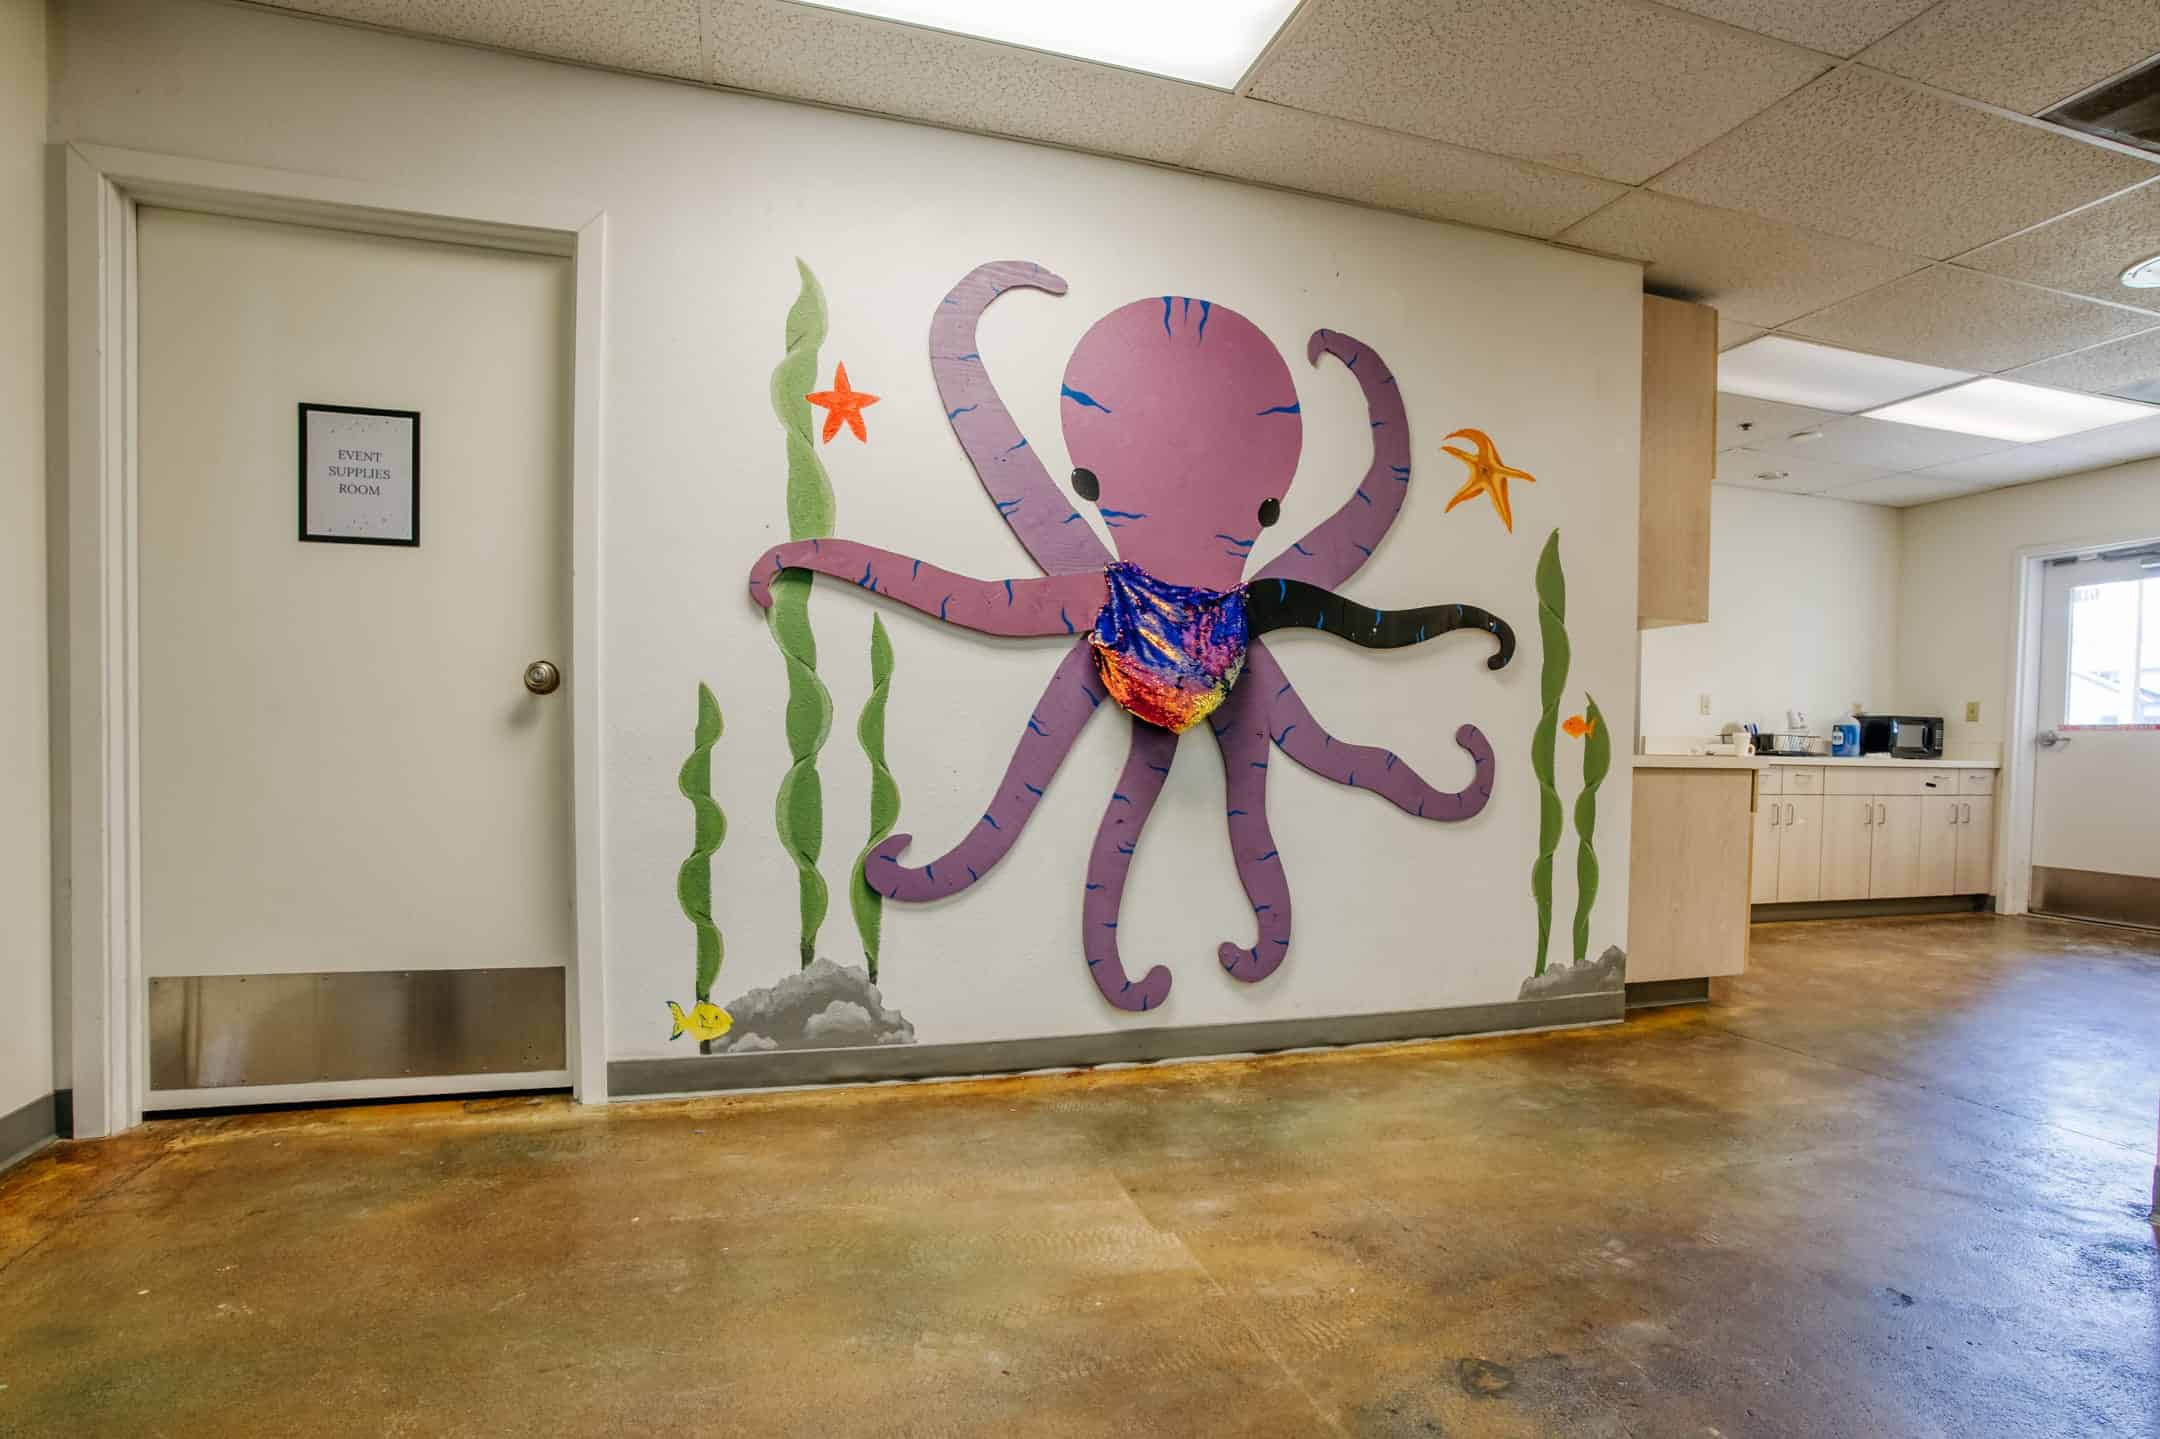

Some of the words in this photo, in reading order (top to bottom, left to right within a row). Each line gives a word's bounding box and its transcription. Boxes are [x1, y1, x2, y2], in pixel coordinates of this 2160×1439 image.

[338, 449, 383, 462] EVENT
[328, 466, 391, 480] SUPPLIES
[338, 483, 381, 496] ROOM
